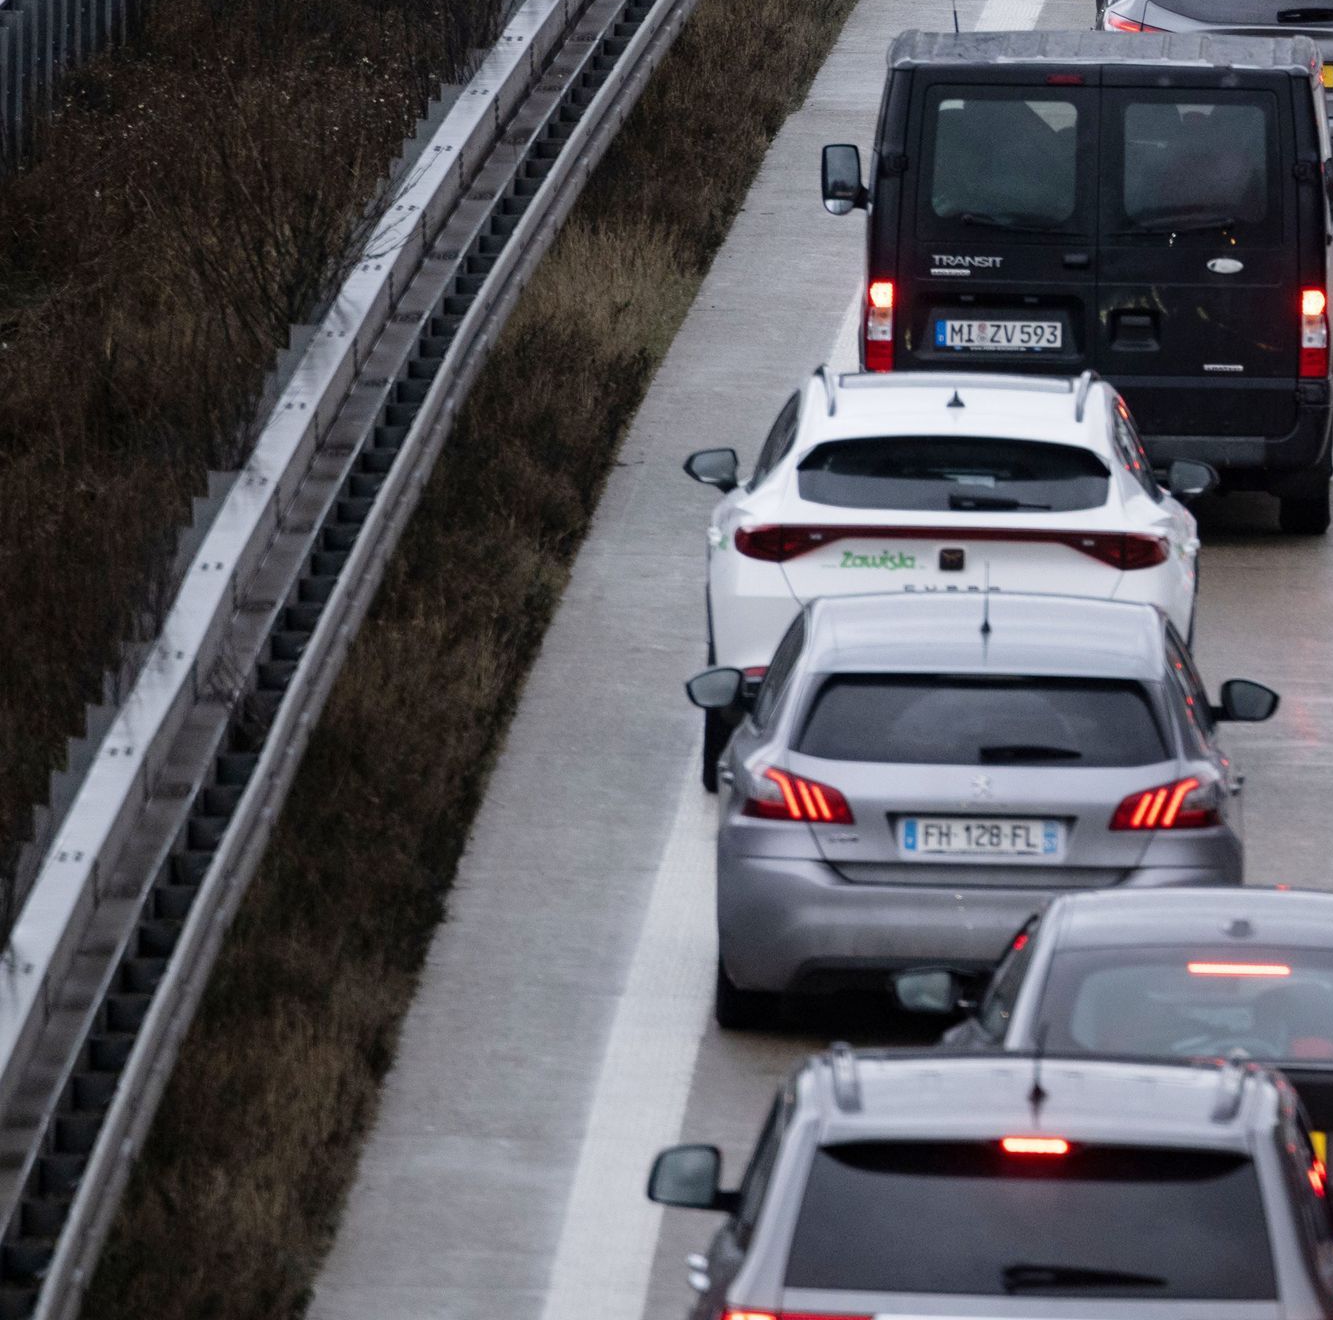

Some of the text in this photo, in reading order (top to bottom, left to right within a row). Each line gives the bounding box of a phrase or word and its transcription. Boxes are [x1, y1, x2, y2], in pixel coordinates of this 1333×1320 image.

[931, 254, 1003, 268] TRANSIT
[950, 323, 1058, 345] MI ZV 593
